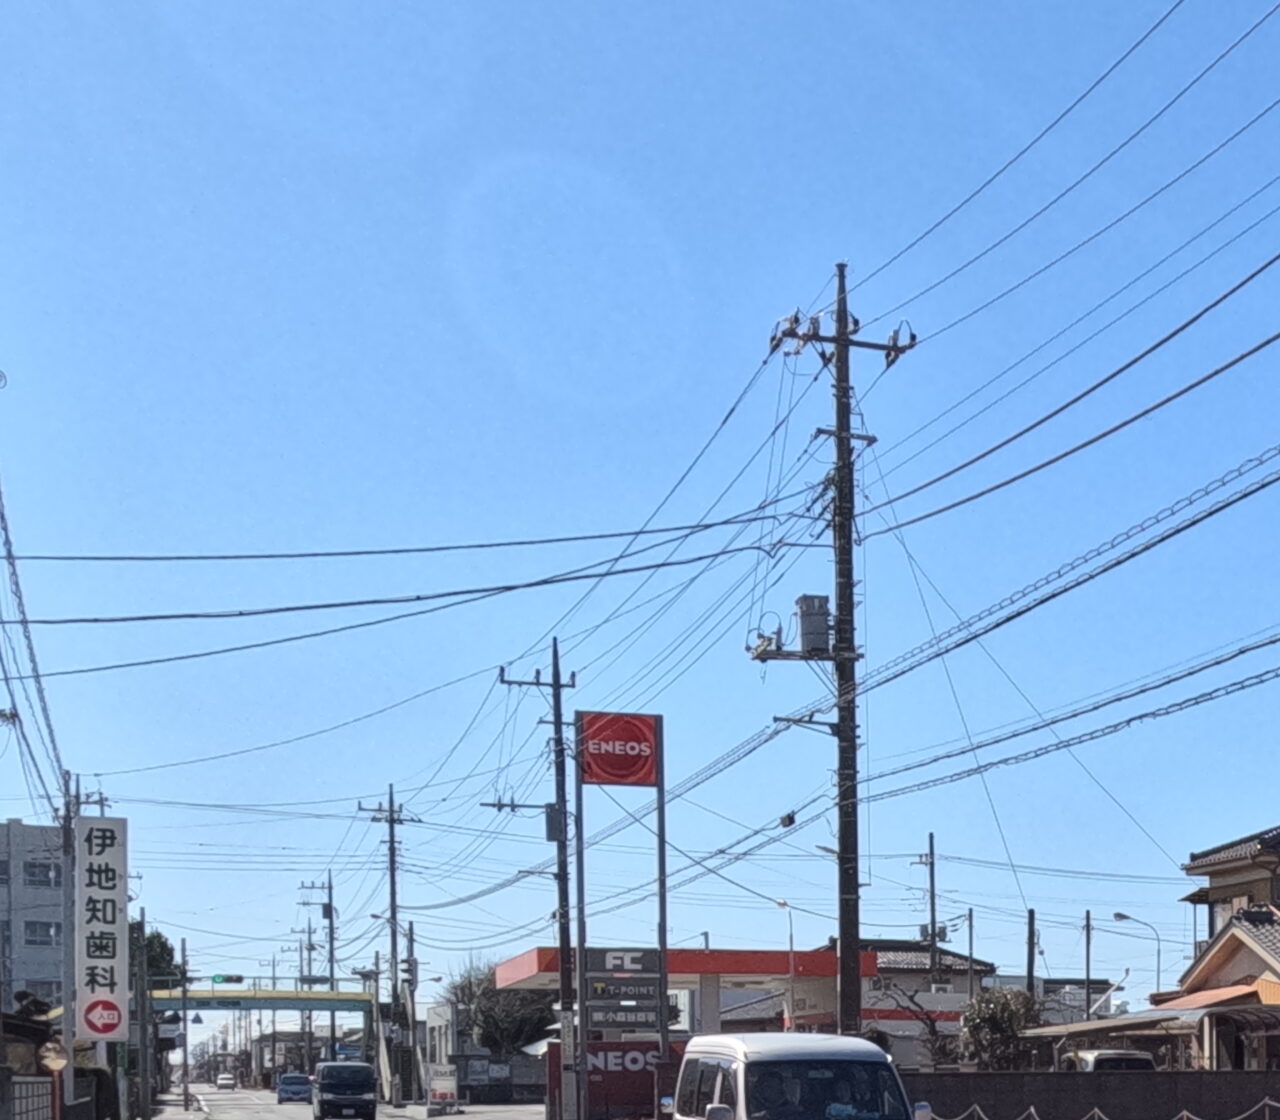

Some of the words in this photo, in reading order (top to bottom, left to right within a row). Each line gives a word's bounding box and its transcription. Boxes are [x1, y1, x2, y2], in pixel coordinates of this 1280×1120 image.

[588, 740, 652, 756] ENEOS
[84, 827, 117, 994] 伊地知歯科
[608, 986, 655, 995] T-POINT
[97, 1012, 115, 1021] 入口
[575, 1050, 661, 1071] NEOS
